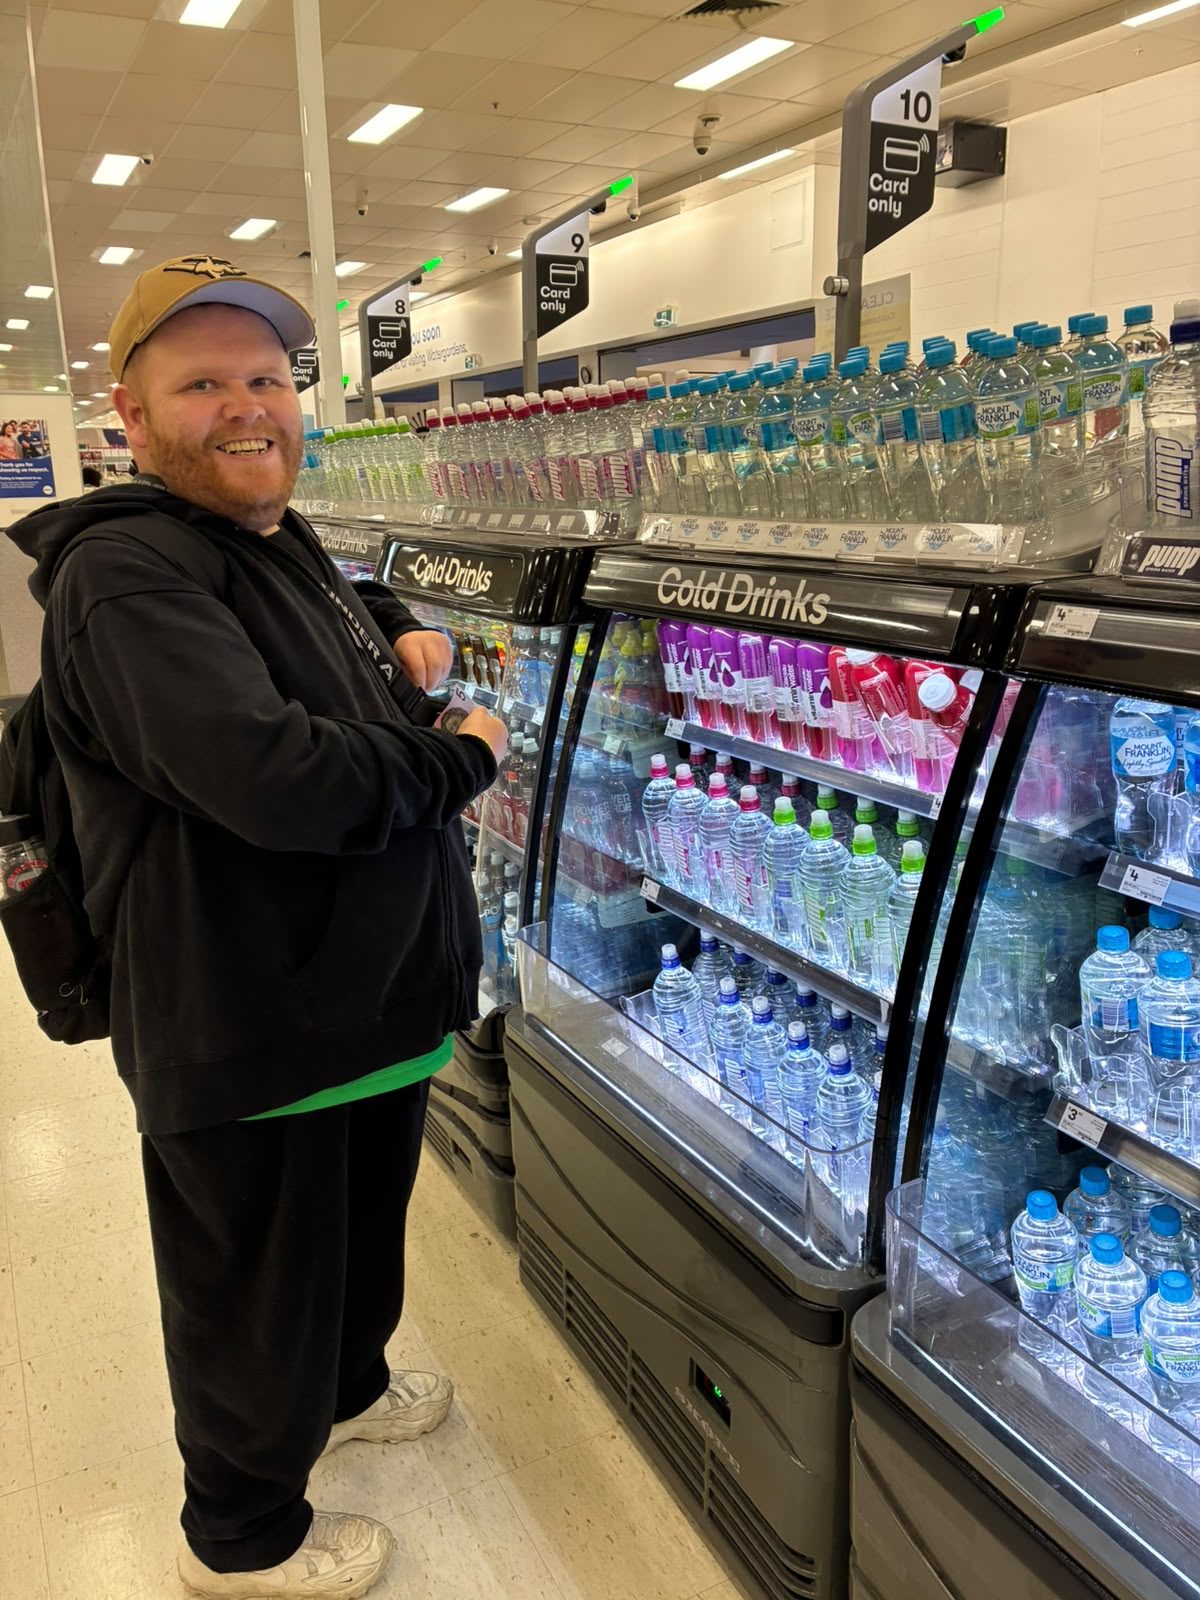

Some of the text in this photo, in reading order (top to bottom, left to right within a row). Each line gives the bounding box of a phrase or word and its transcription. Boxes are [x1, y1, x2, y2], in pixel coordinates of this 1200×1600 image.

[900, 89, 932, 123] 10
[869, 173, 909, 195] Card
[868, 195, 902, 219] only
[571, 233, 585, 253] 9
[540, 286, 571, 299] Card
[395, 300, 406, 315] 8
[540, 300, 566, 314] only
[422, 325, 441, 342] soon
[372, 339, 397, 349] Card
[373, 349, 394, 359] only
[292, 366, 313, 375] Card
[293, 374, 311, 383] only
[1092, 381, 1115, 390] MOUNT
[1084, 384, 1121, 398] FRANKLIN
[1040, 394, 1062, 407] KLIN
[976, 408, 1019, 424] FRANKLIN
[982, 405, 1009, 415] MOUNT
[320, 527, 368, 554] Cold Drinks
[803, 531, 829, 541] FRANKLIN
[840, 533, 868, 544] FRANKLIN
[879, 530, 907, 541] FRANKLIN
[1137, 544, 1200, 576] pump
[414, 553, 493, 592] Cold Drinks
[657, 566, 831, 625] Cold Drinks
[456, 687, 466, 701] 5
[1125, 746, 1169, 758] FRANKLIN
[1133, 741, 1162, 751] MOUNT
